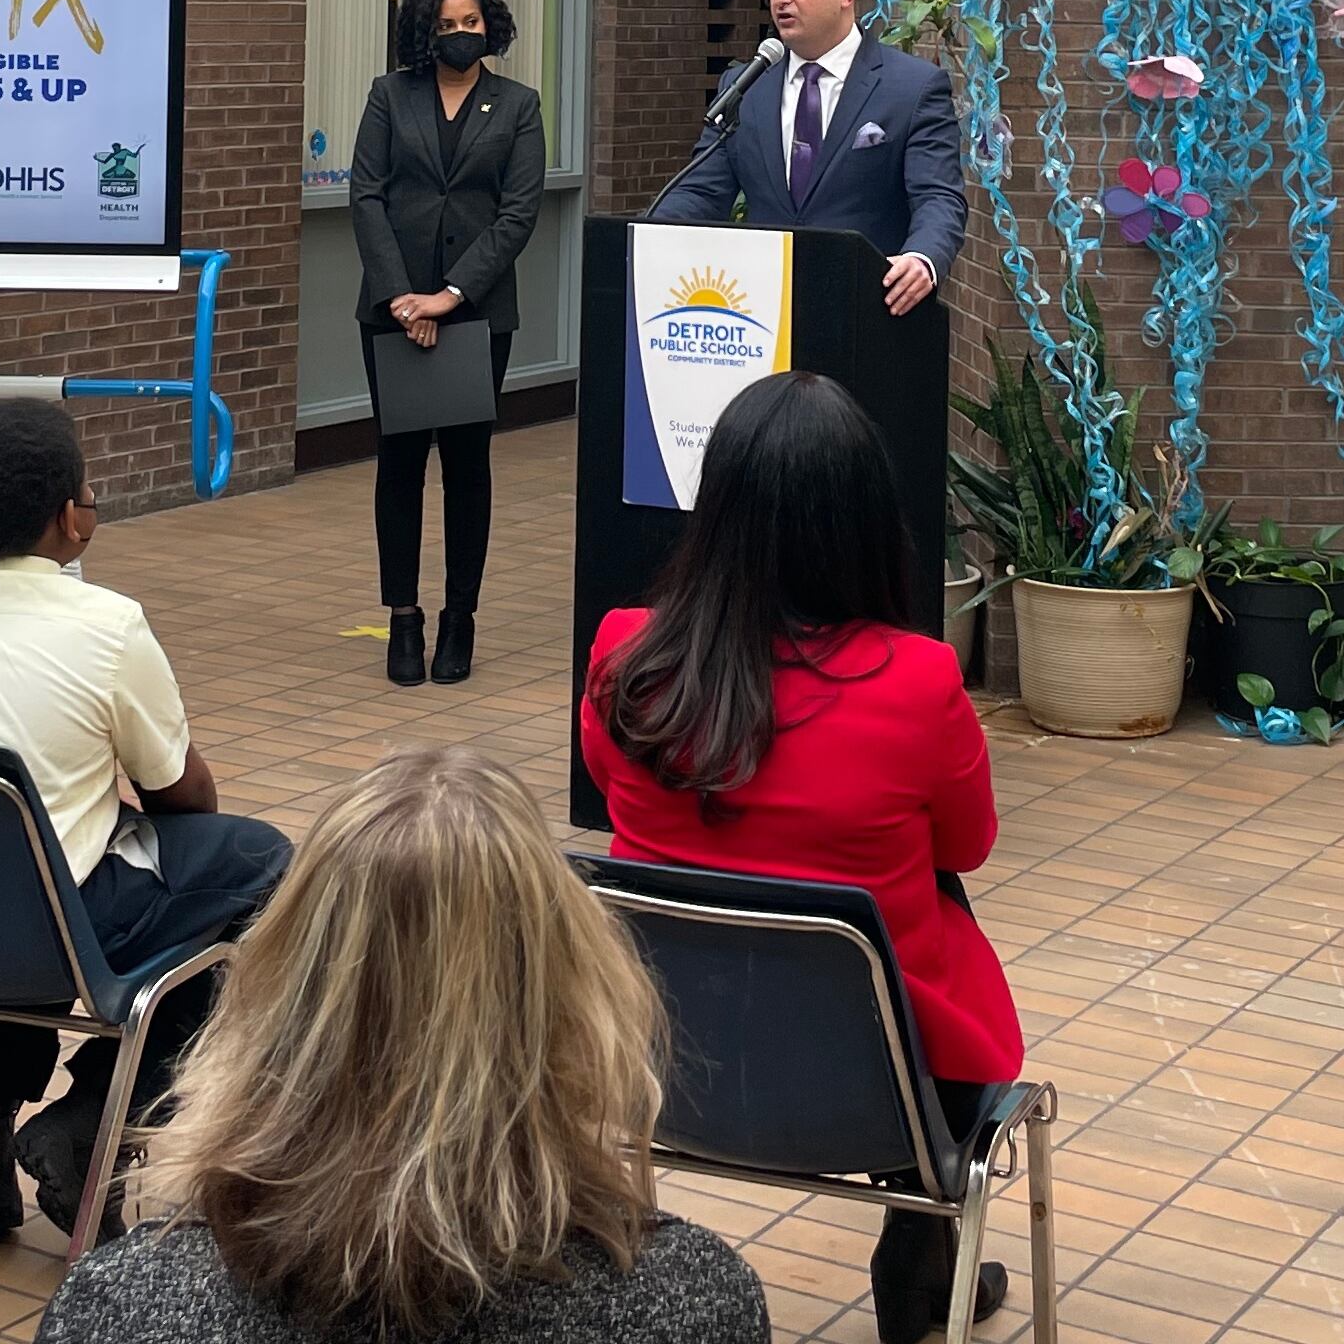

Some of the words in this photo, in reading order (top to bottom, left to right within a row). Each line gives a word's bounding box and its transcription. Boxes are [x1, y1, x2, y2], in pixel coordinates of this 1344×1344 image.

[11, 78, 33, 102] &
[41, 79, 87, 102] UP
[100, 203, 139, 212] HEALTH
[667, 321, 746, 343] DETROIT
[650, 338, 696, 354] PUBLIC
[699, 341, 763, 358] SCHOOLS
[667, 354, 712, 366] COMMUNITY
[713, 357, 746, 367] DISTRICT
[669, 419, 714, 434] Student
[676, 434, 695, 449] We
